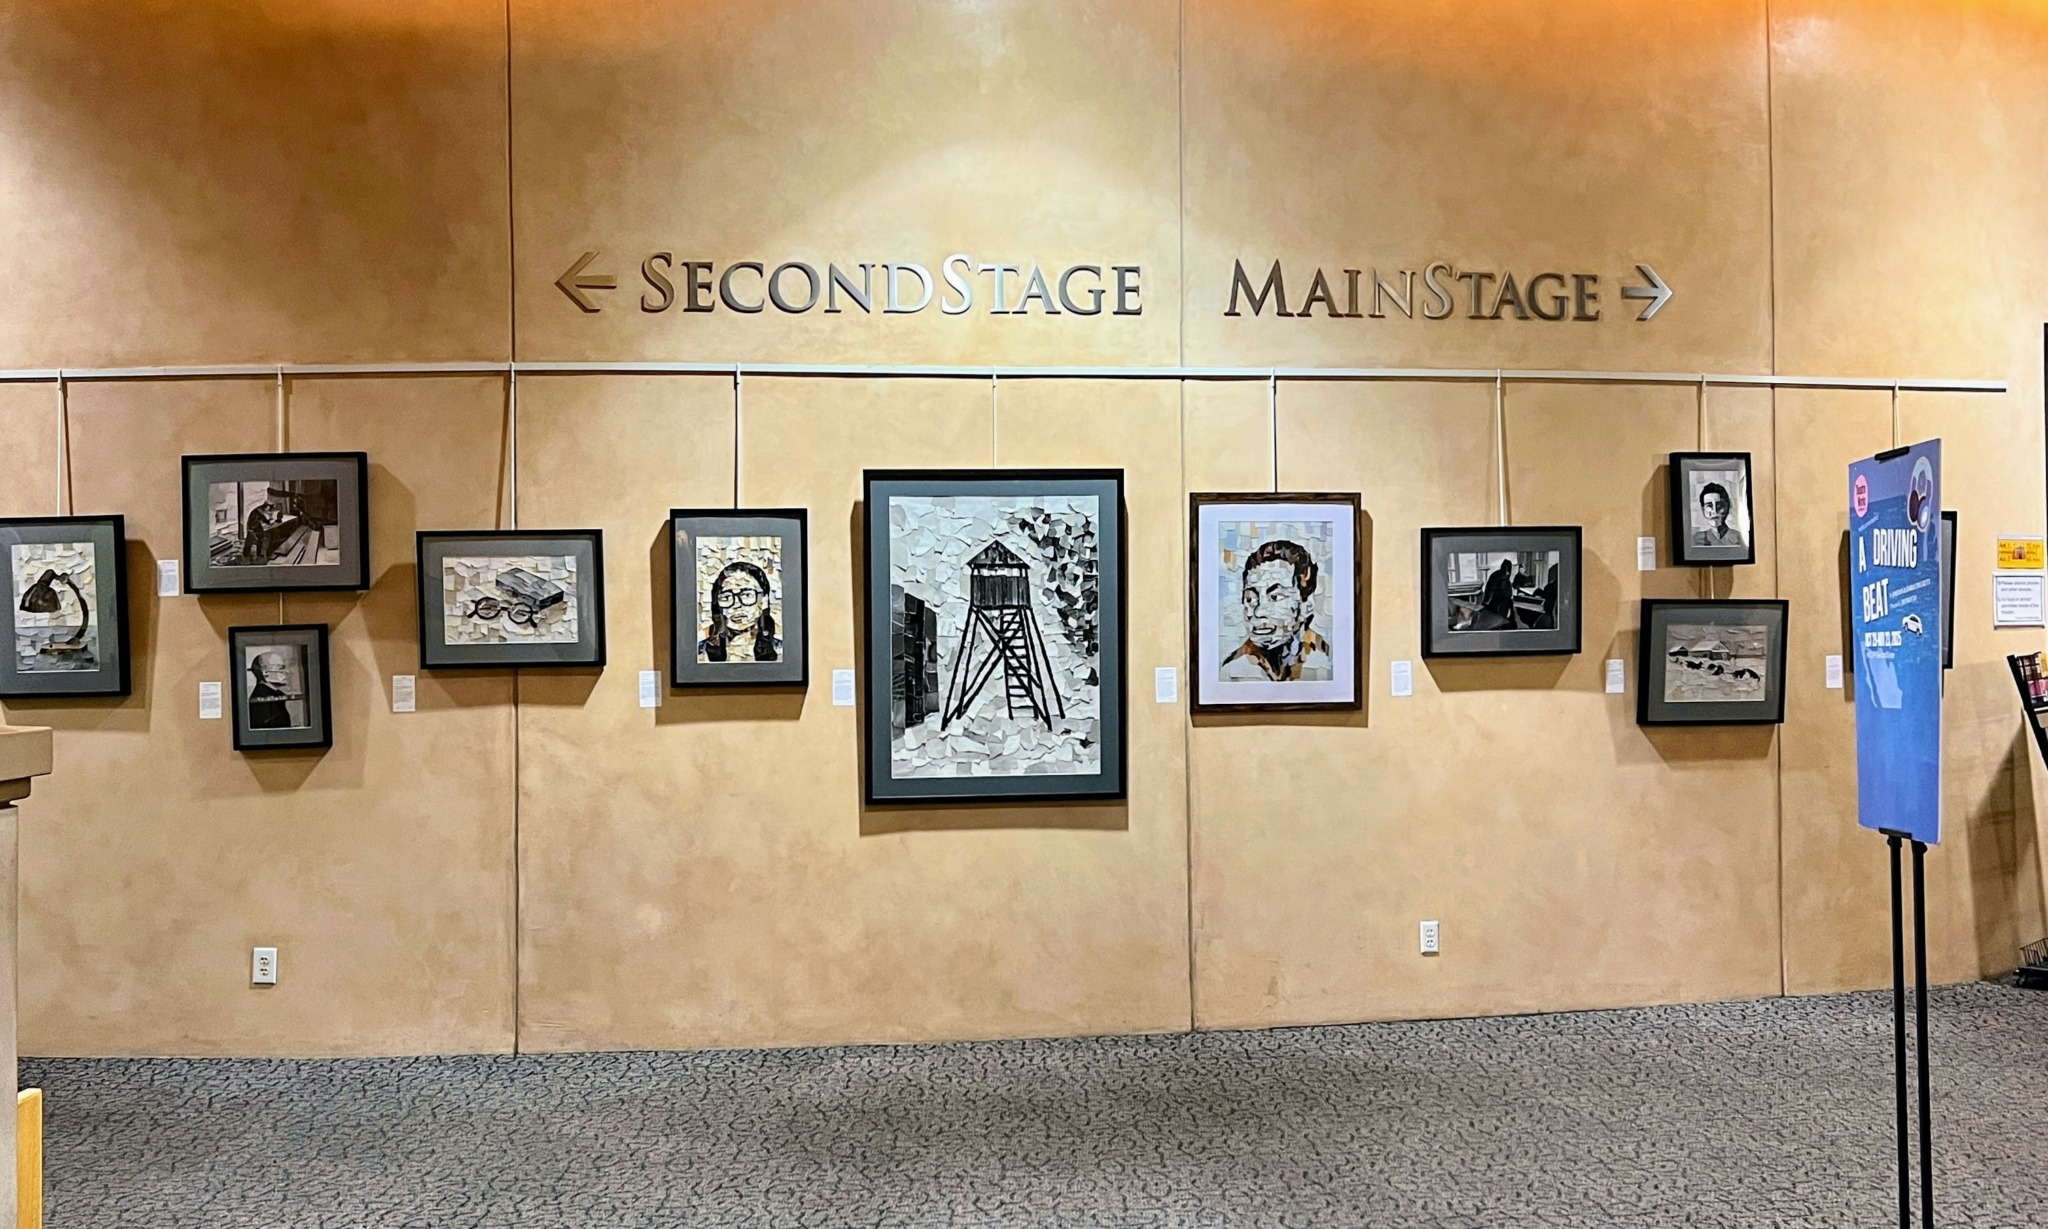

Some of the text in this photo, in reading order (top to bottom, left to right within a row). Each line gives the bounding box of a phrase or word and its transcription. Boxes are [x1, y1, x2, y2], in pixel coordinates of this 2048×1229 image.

[1858, 528, 1918, 574] A DRIVING
[1862, 577, 1889, 624] BEAT
